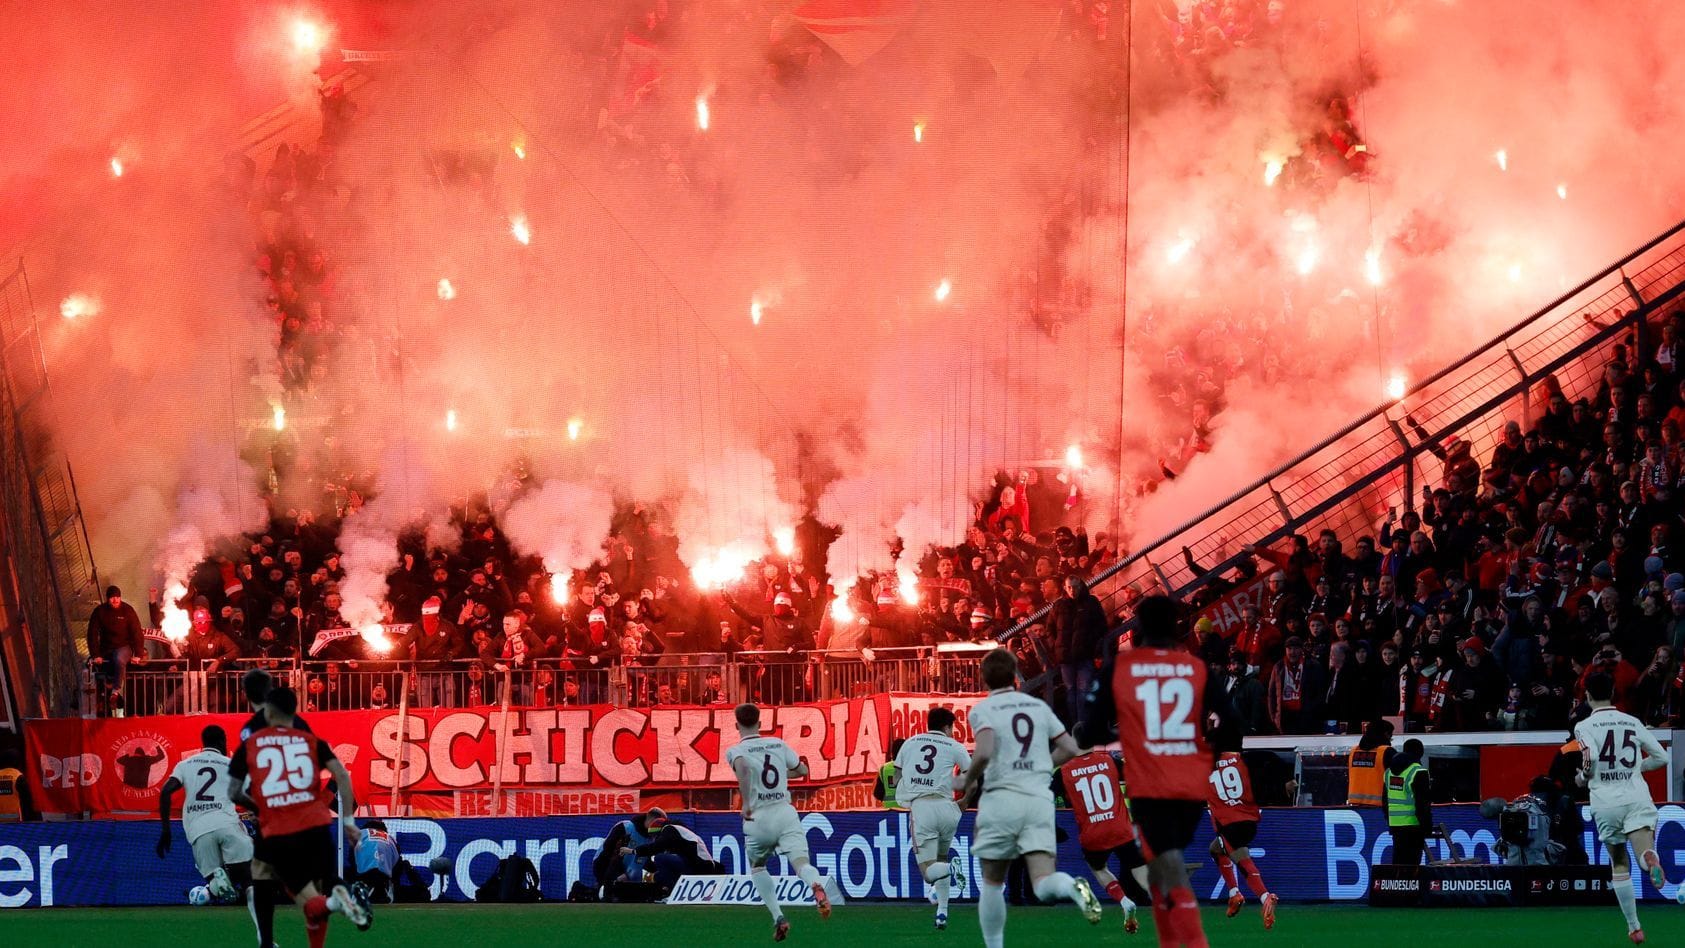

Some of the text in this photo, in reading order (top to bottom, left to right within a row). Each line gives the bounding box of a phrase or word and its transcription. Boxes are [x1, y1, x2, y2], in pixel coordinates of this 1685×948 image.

[1136, 678, 1196, 740] 12
[370, 699, 887, 788] SCHICKERIA
[1012, 712, 1034, 759] 9
[1598, 729, 1637, 769] 45
[256, 742, 314, 797] 25
[761, 753, 779, 790] 6
[915, 744, 938, 775] 3
[1071, 762, 1109, 777] BAYER 04
[195, 766, 217, 801] 2
[911, 777, 934, 787] MINJAE
[1074, 773, 1114, 814] 10
[1208, 766, 1244, 801] 19
[1089, 811, 1114, 824] WIRTZ
[1380, 879, 1419, 891] BUNDESLIGA
[1441, 879, 1512, 891] BUNDESLIGA
